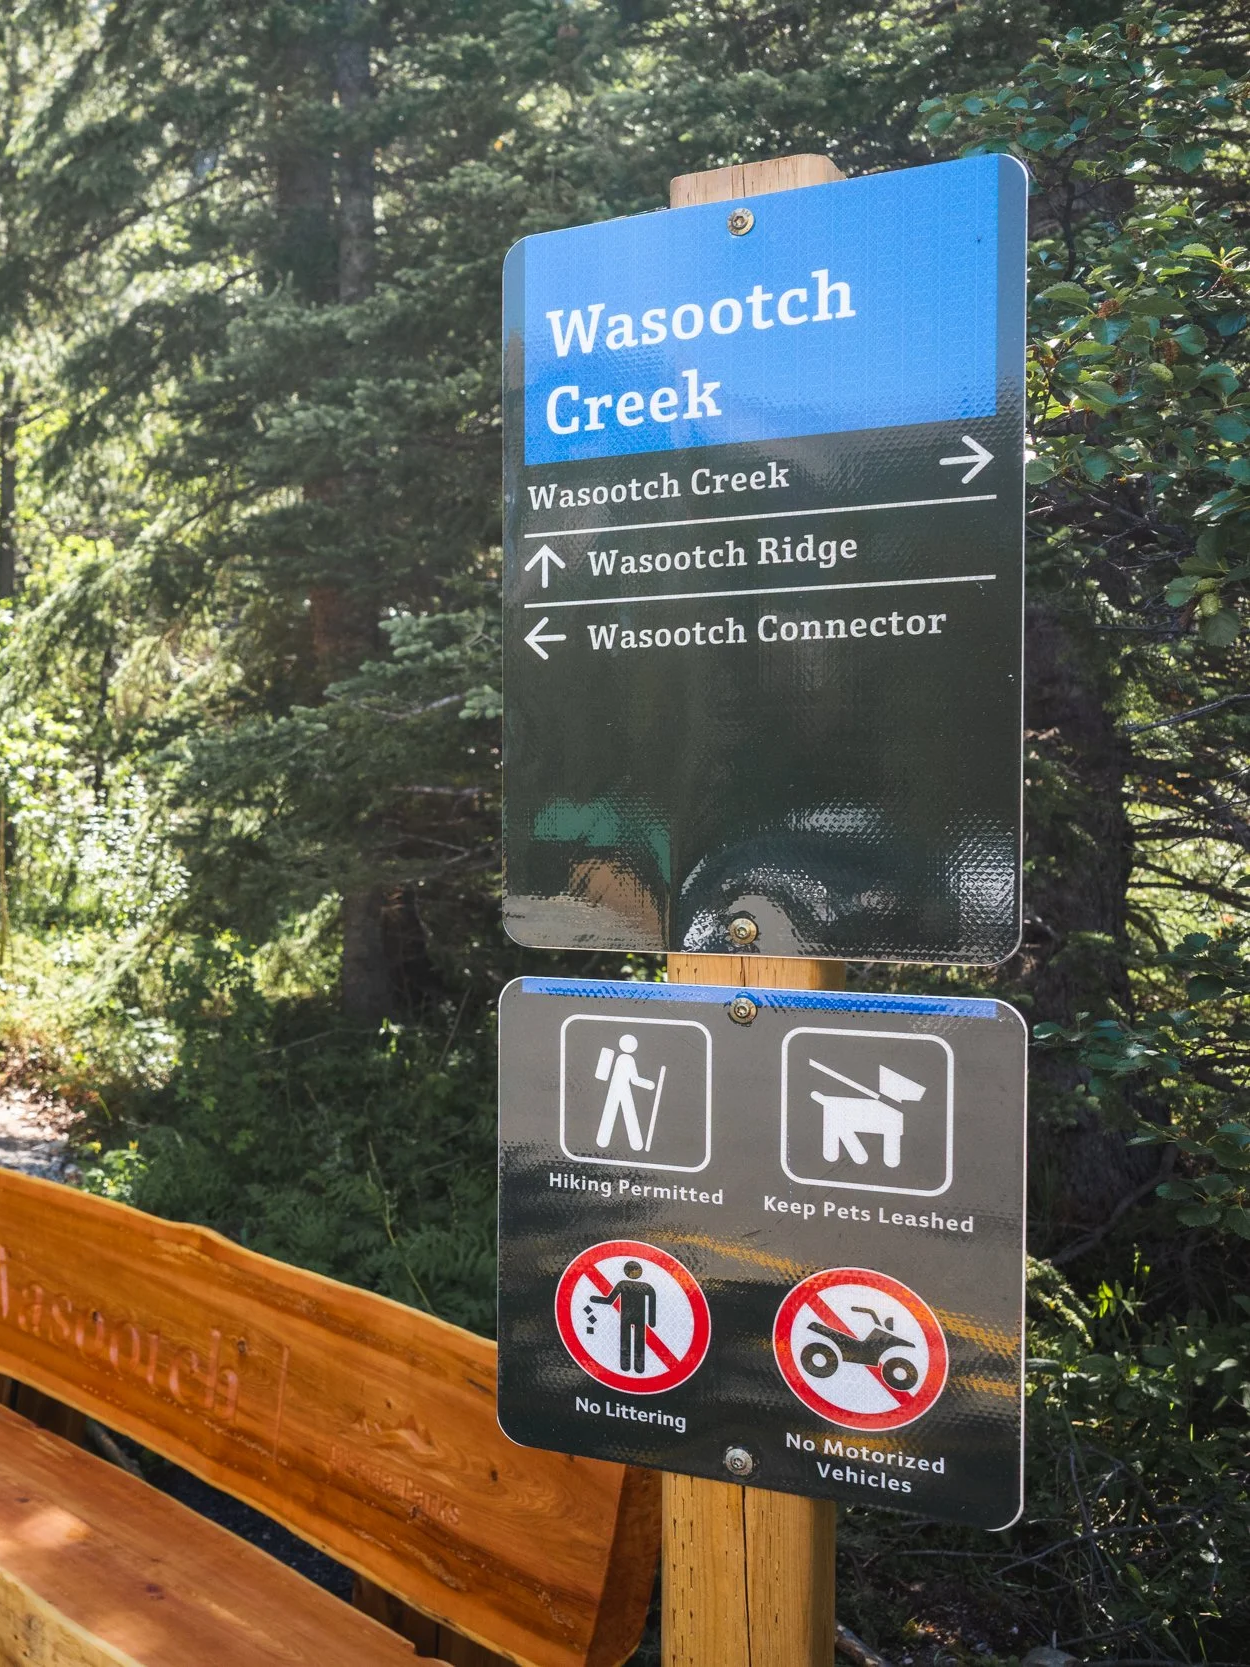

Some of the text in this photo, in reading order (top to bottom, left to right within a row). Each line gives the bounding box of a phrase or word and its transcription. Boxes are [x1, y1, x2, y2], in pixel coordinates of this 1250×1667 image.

[545, 268, 856, 357] Wasootch
[546, 368, 722, 435] Creek
[527, 461, 790, 511] Wasootch Creek
[586, 533, 858, 577] Wasootch Ridge
[586, 611, 947, 651] Wasootch Connector
[549, 1172, 724, 1205] Hiking Permitted
[764, 1195, 974, 1233] Keep Pets Leashed
[575, 1396, 686, 1434] No Littering
[786, 1432, 945, 1474] No Motorized
[816, 1461, 912, 1493] Vehicles
